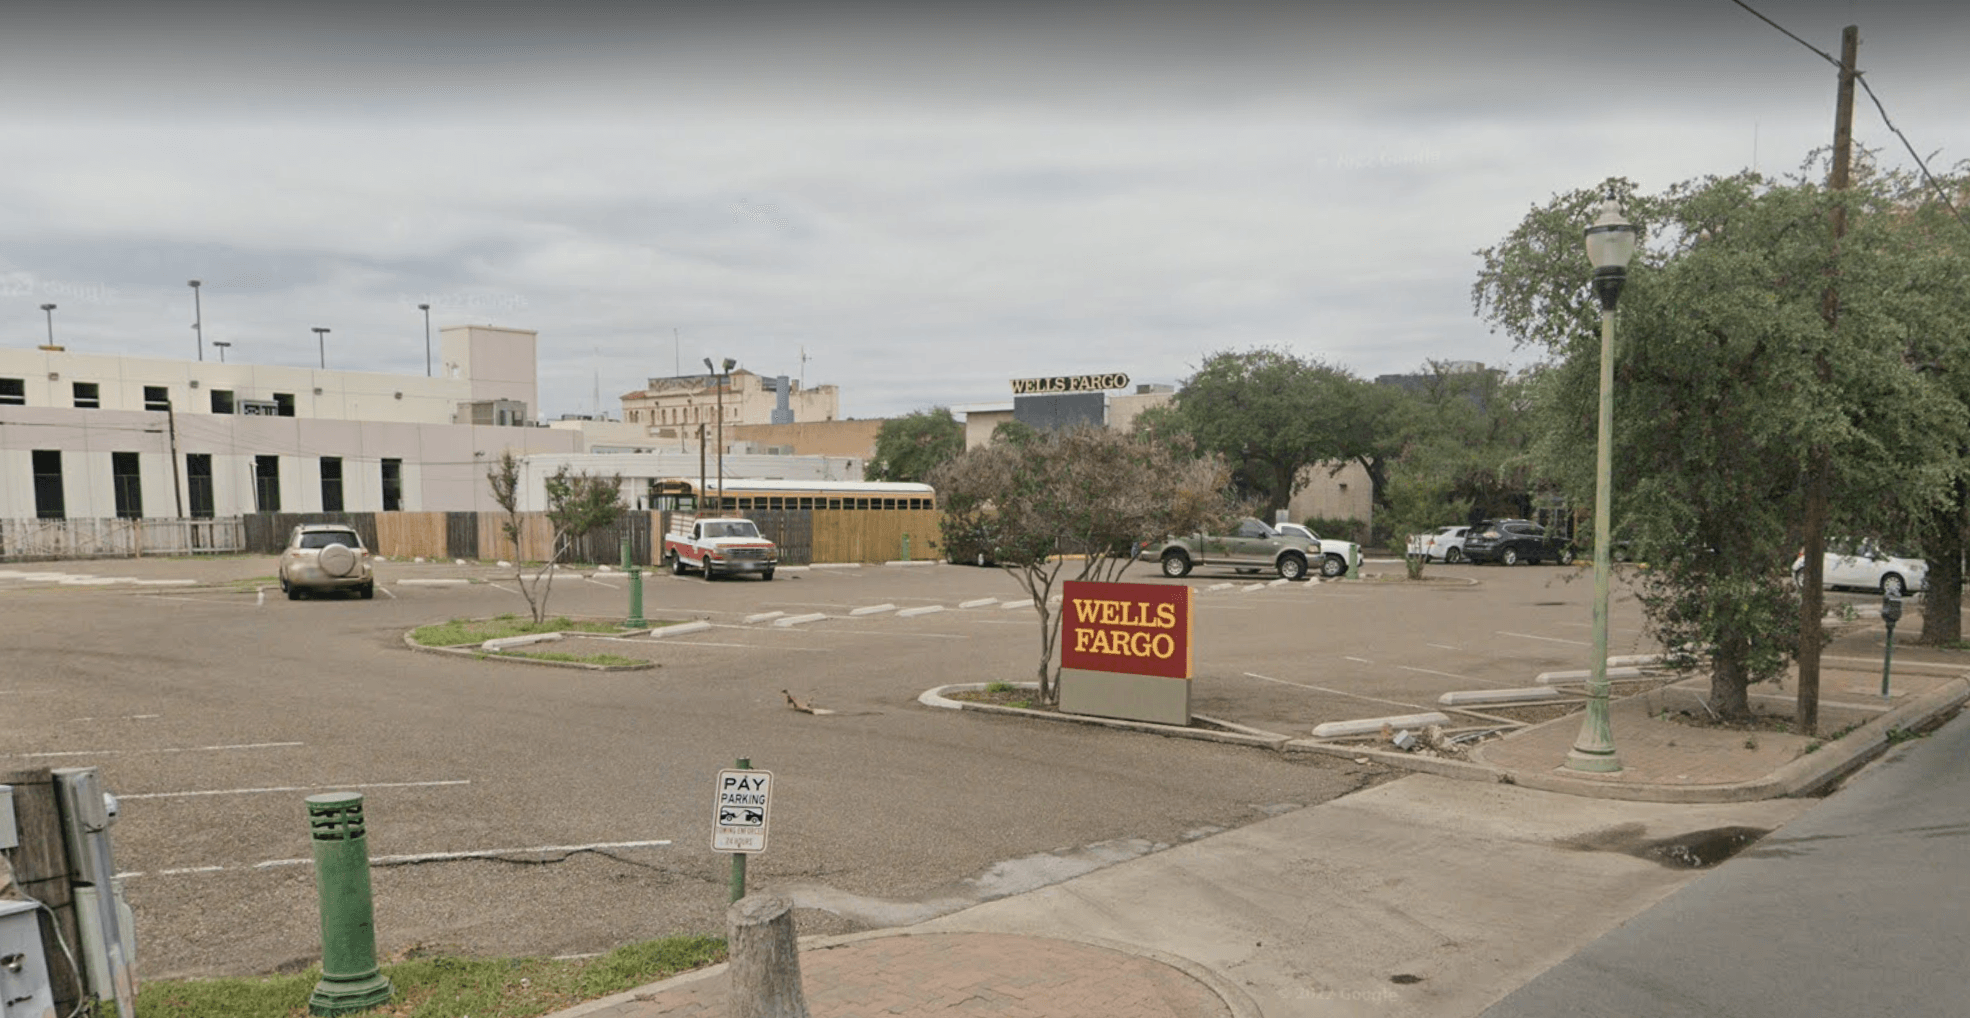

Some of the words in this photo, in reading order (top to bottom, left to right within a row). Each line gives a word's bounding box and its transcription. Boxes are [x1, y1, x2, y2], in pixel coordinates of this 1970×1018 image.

[1009, 377, 1066, 394] WELLS
[1069, 373, 1128, 390] FARGO
[1072, 598, 1176, 629] WELLS
[1074, 628, 1175, 659] FARGO
[724, 777, 765, 791] PAY
[720, 793, 766, 805] PARKING
